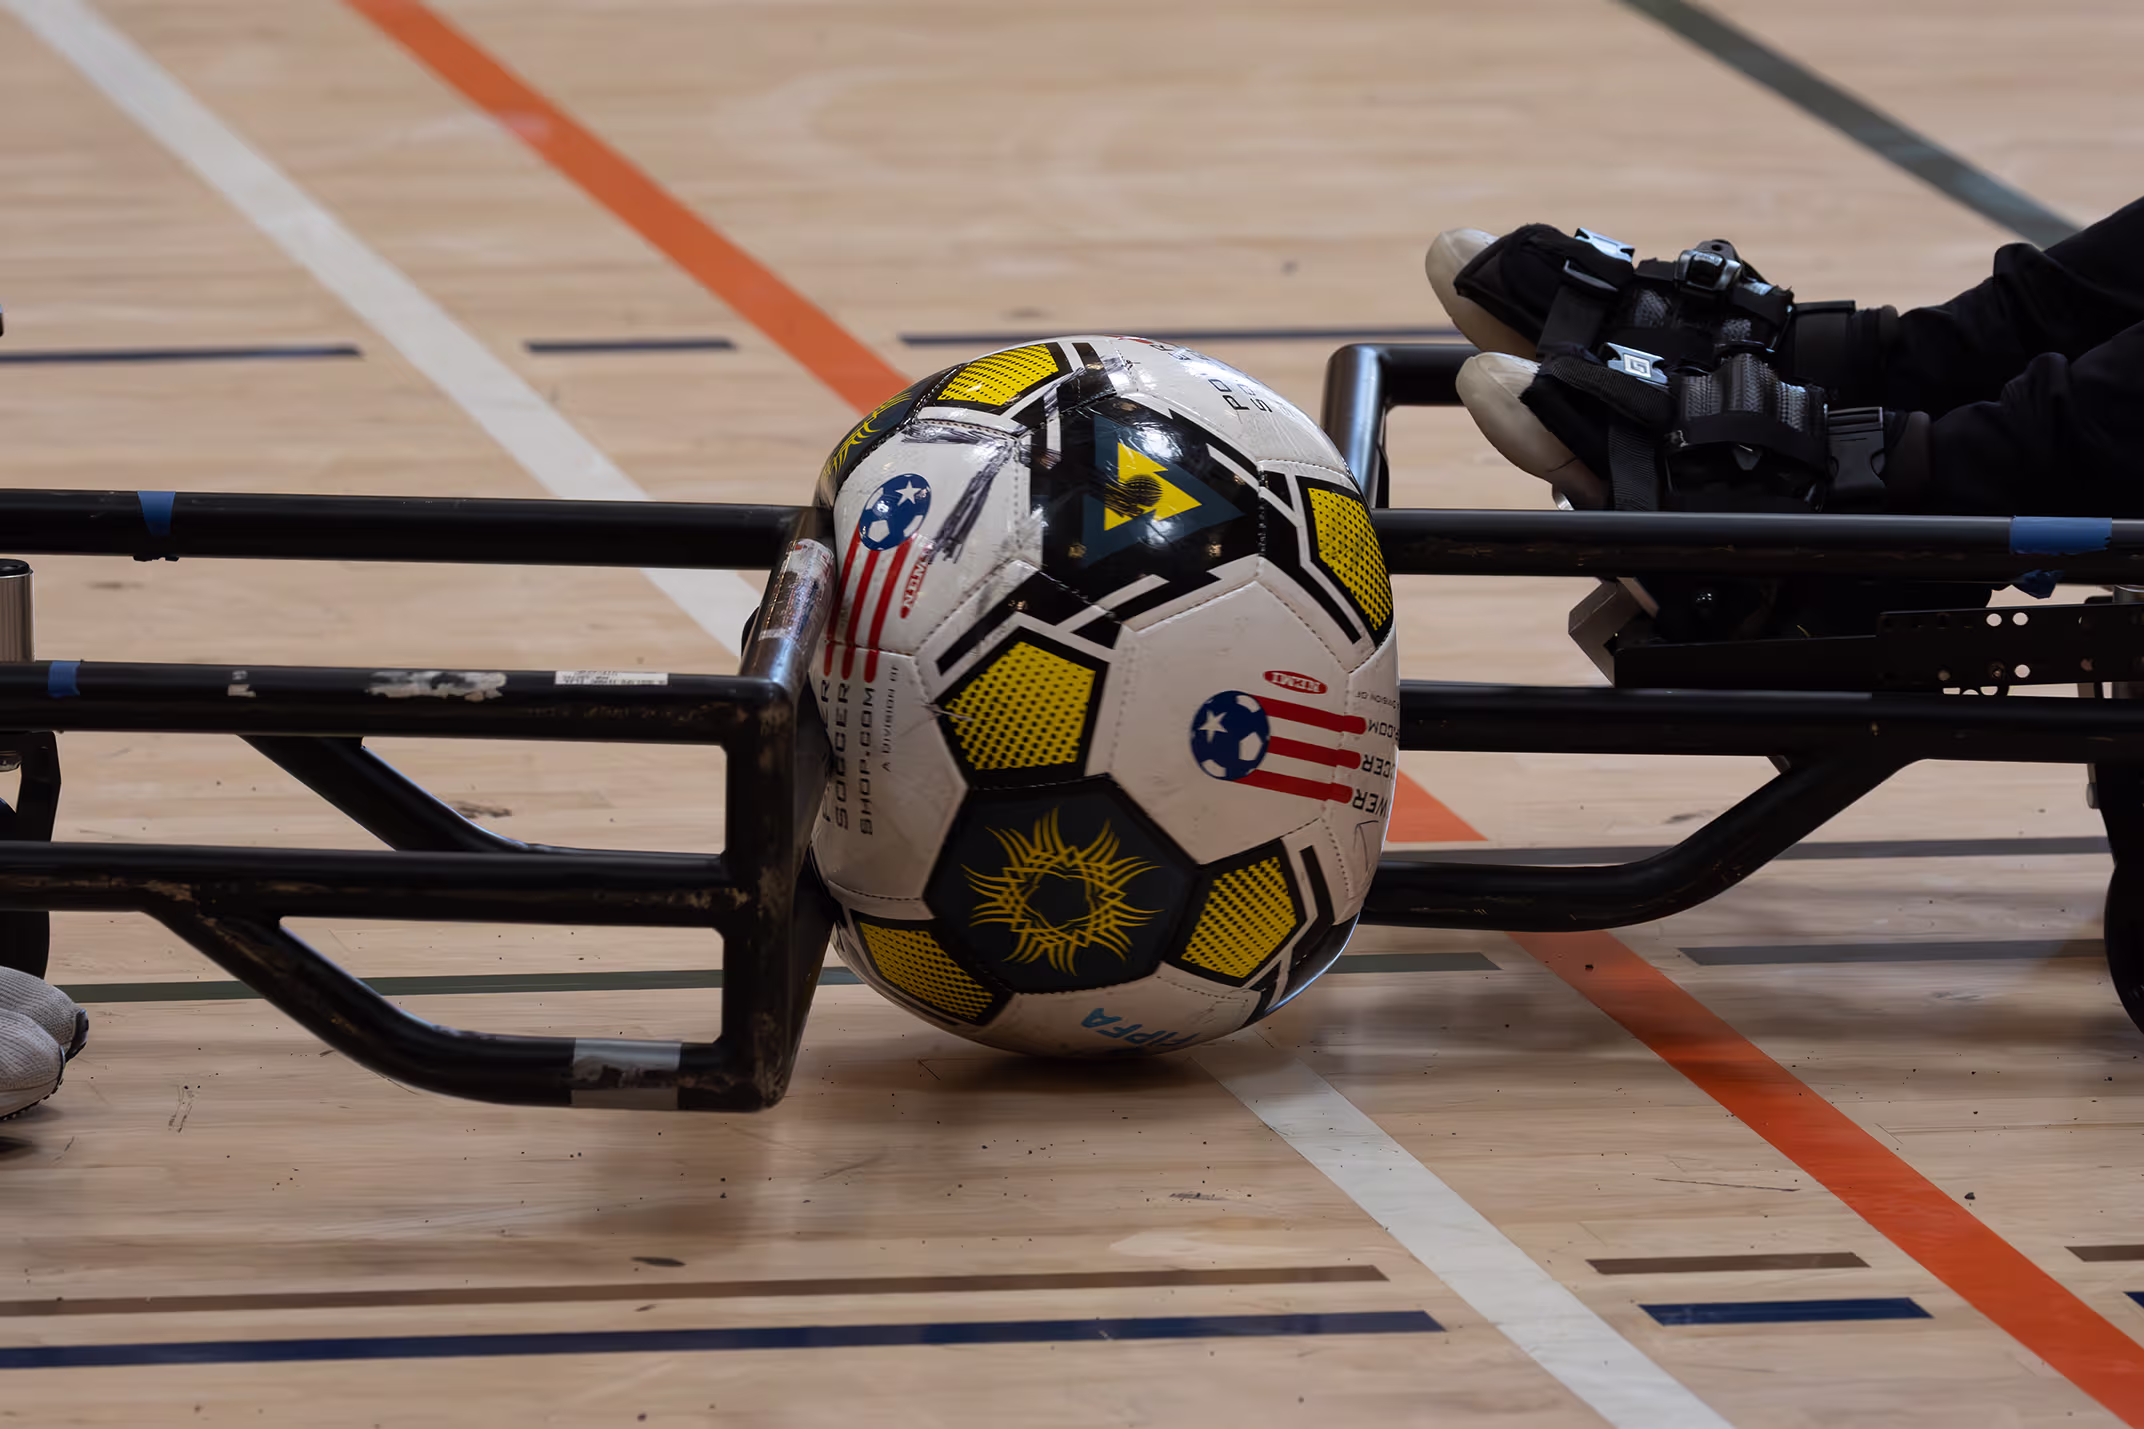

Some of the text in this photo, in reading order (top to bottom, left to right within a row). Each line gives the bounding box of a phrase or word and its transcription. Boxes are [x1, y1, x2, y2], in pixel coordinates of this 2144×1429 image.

[1150, 344, 1250, 411] POER
[834, 682, 850, 831] SOCCER
[858, 687, 876, 836] SHOP.COM
[1352, 788, 1389, 818] WER
[1081, 1007, 1200, 1047] FIPFA
